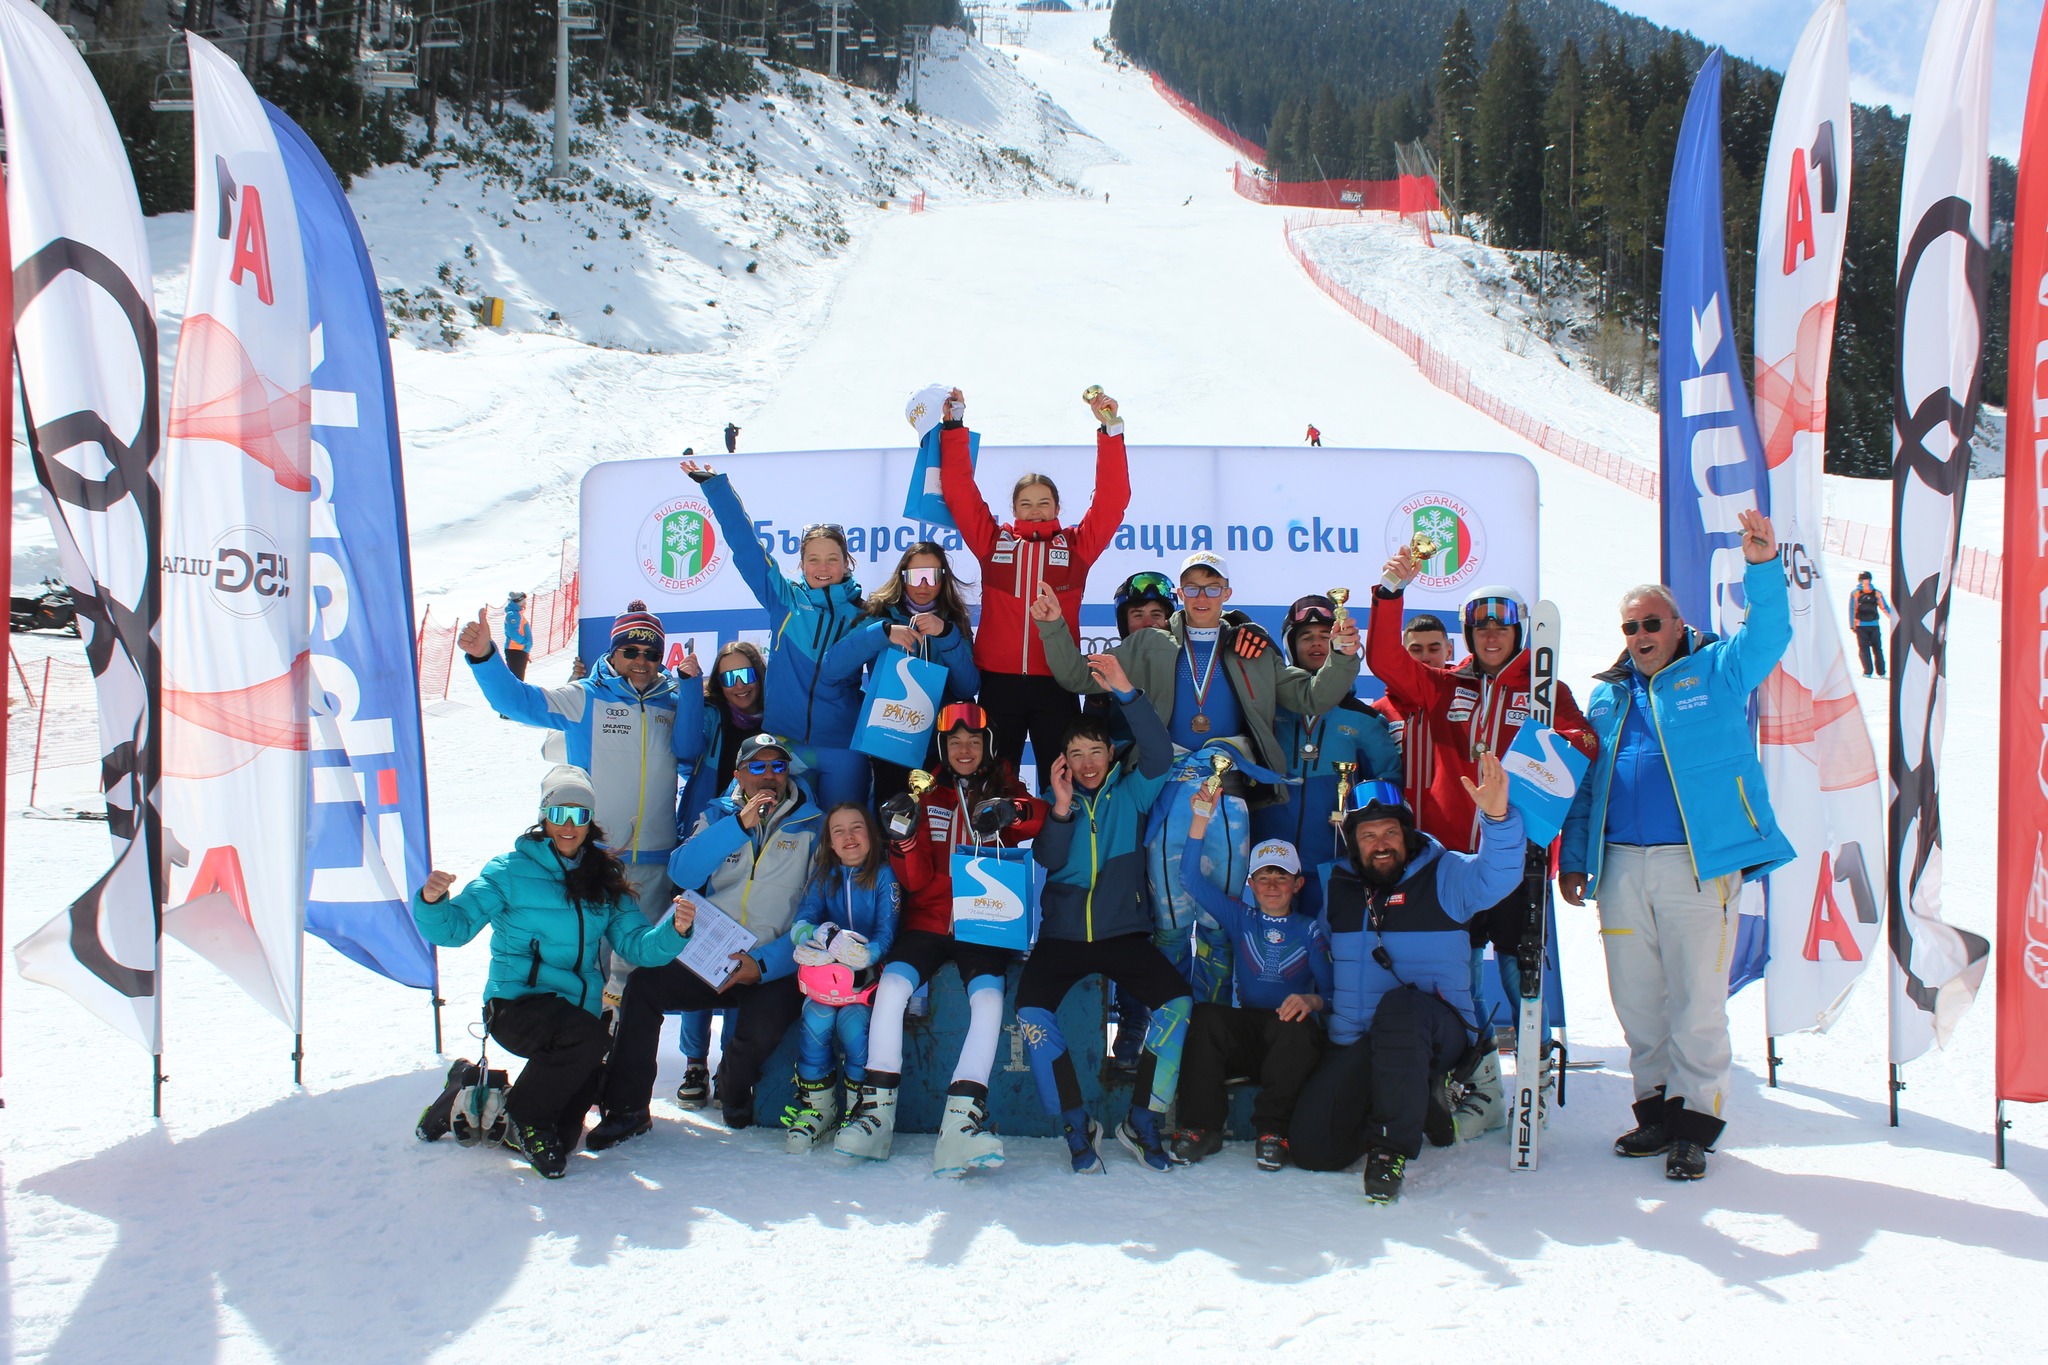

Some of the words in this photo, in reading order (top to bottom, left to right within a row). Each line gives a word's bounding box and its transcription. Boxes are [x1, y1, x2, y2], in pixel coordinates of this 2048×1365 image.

[1784, 120, 1837, 275] A1
[653, 501, 715, 521] BULGARIAN
[1402, 495, 1468, 517] BULGARIAN
[753, 520, 963, 562] Бъарска
[1227, 525, 1274, 552] по
[1288, 517, 1359, 553] ски
[643, 559, 658, 577] SKI
[658, 555, 721, 589] FEDERATION
[665, 638, 694, 672] A1
[1534, 646, 1553, 728] EAD
[602, 723, 632, 731] UNLIMITED
[928, 807, 951, 818] Fibank
[1803, 841, 1878, 961] A1
[1517, 1087, 1533, 1168] HEAD
